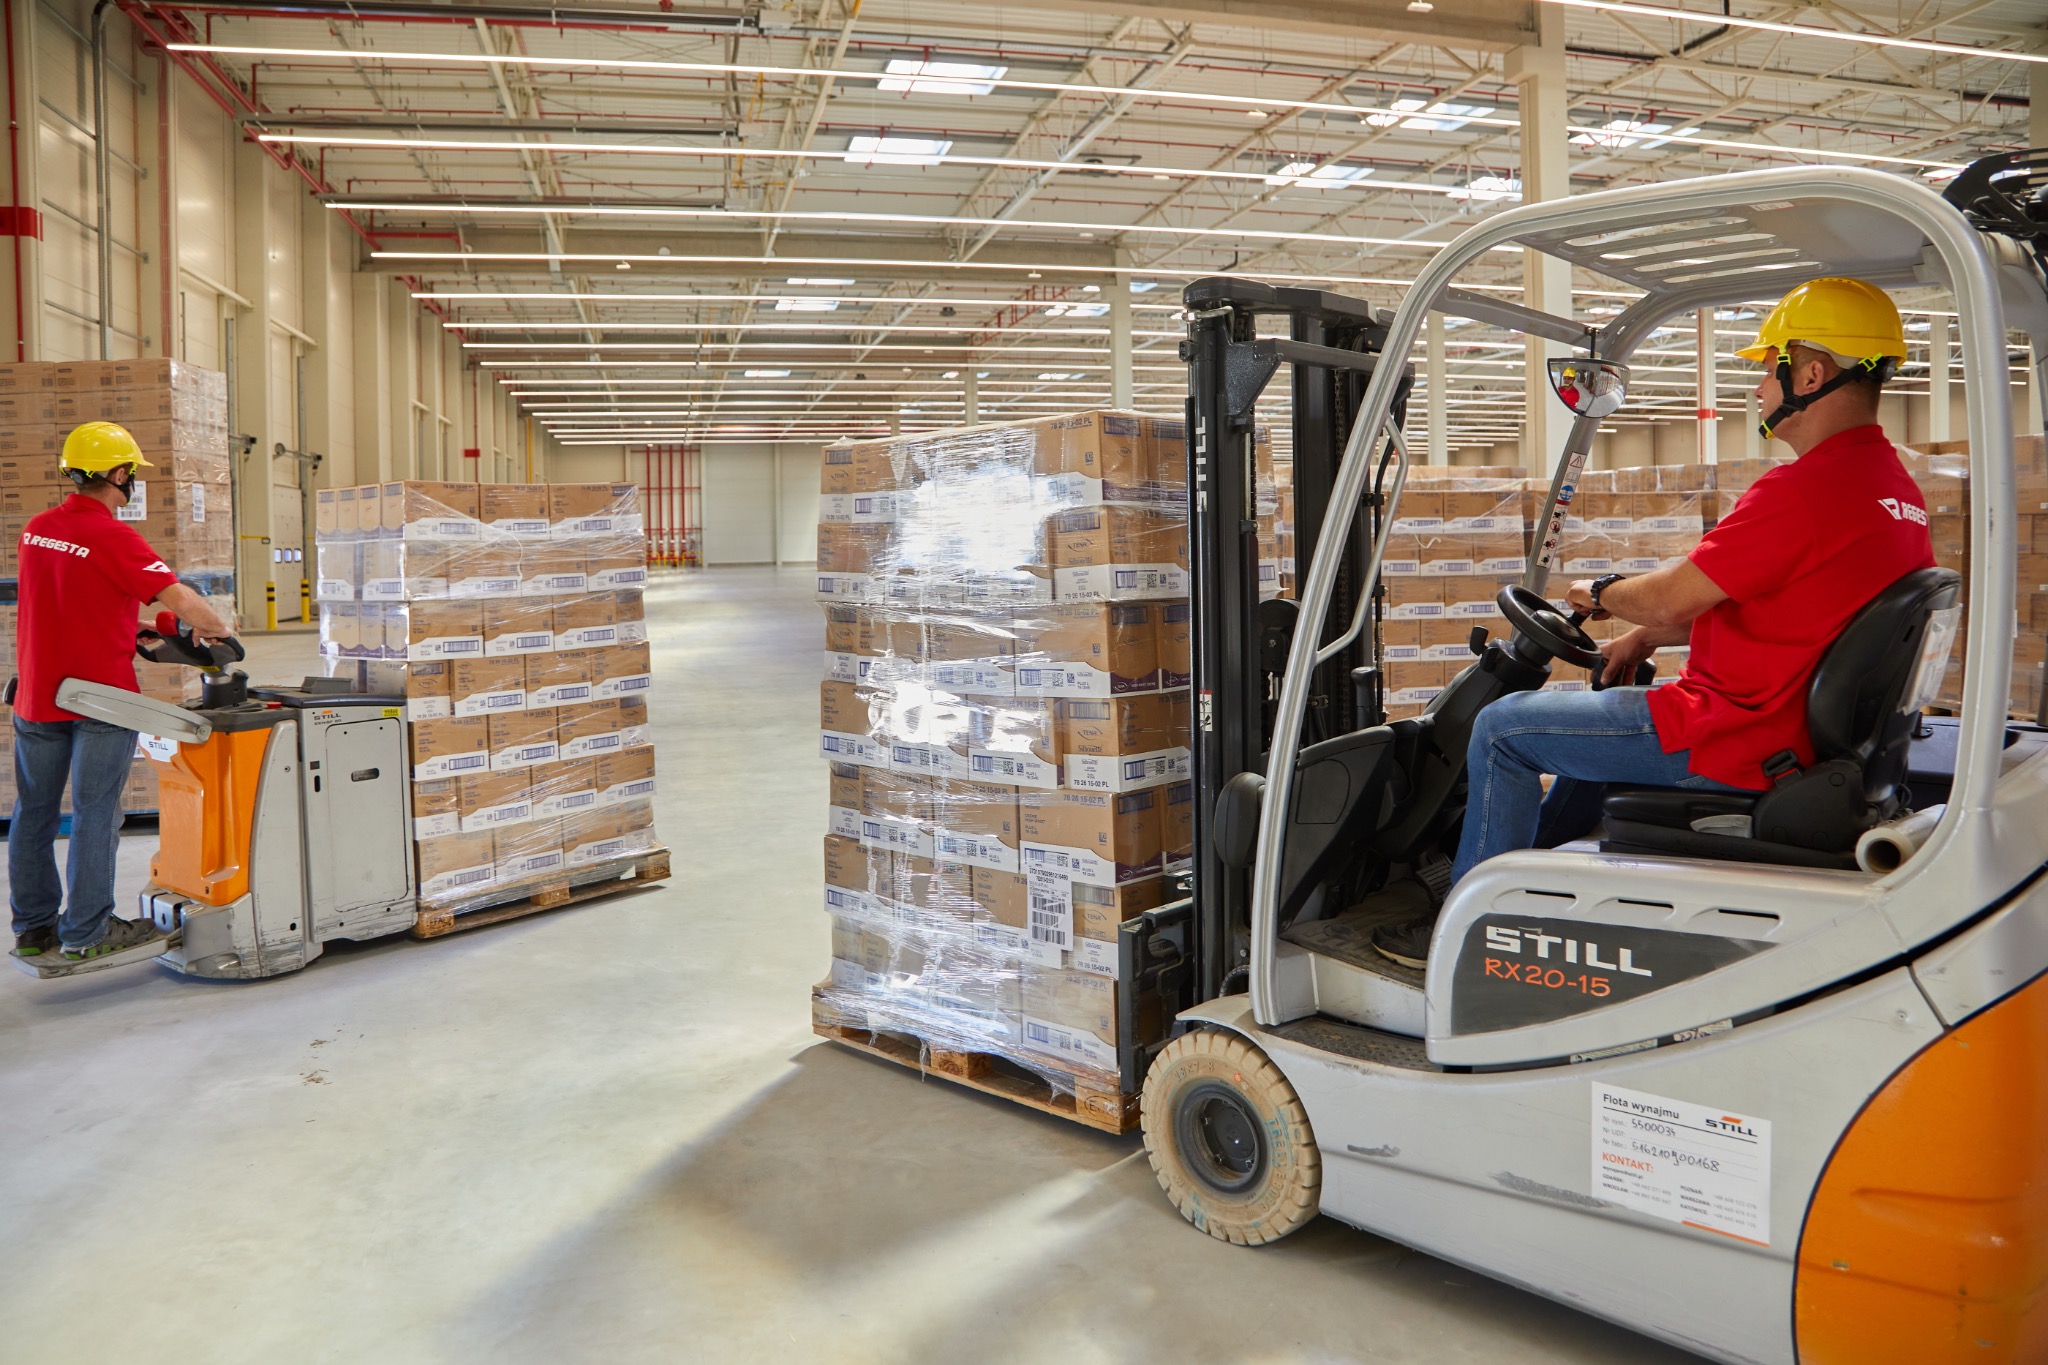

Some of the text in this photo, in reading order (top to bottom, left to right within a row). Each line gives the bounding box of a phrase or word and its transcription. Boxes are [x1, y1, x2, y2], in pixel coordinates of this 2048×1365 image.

[1196, 416, 1208, 512] STILL
[1901, 501, 1928, 526] REGES
[30, 535, 90, 558] REGESTA
[148, 741, 169, 751] STILL
[1486, 925, 1652, 977] STILL
[1091, 963, 1105, 971] 15-02
[1485, 957, 1611, 997] RX20-15
[1099, 981, 1107, 989] PL
[1603, 1093, 1680, 1119] Flota wynajmu
[1631, 1118, 1676, 1136] 5500034
[1705, 1118, 1758, 1137] STILL
[1602, 1152, 1654, 1173] KONTAKT:
